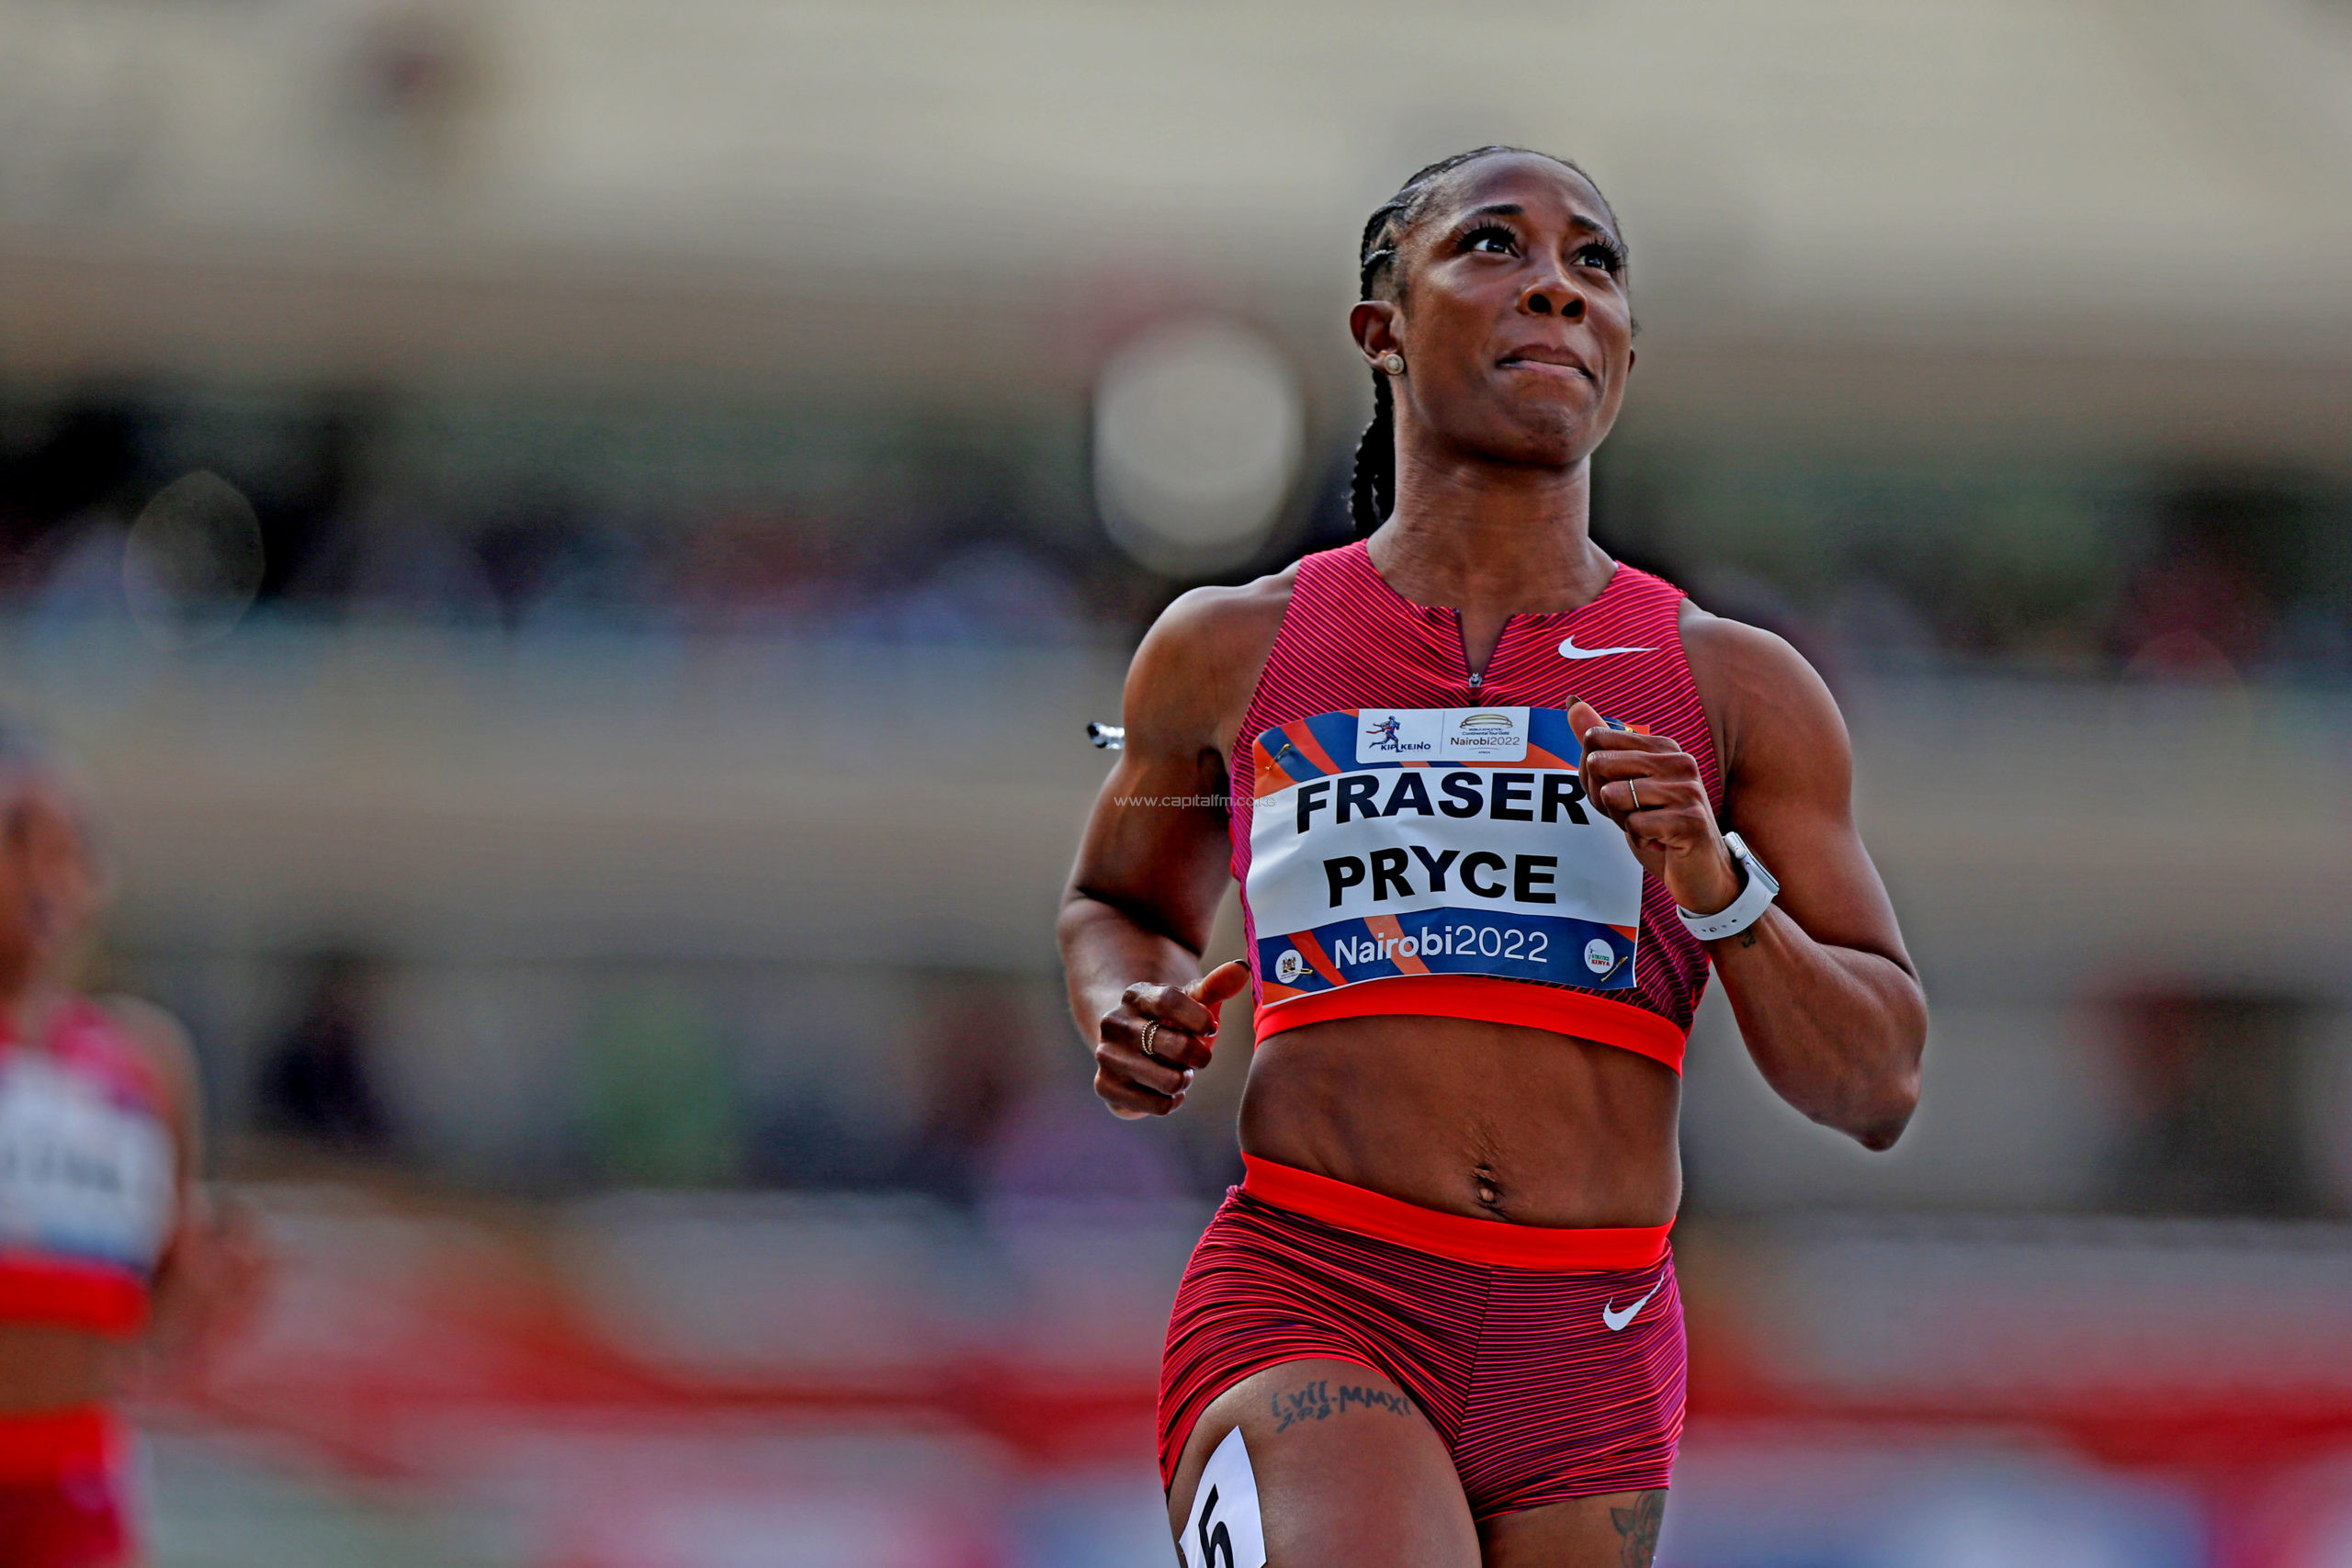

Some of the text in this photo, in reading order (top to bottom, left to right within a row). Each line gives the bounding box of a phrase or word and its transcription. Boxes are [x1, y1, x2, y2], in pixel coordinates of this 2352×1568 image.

[1400, 741, 1431, 750] KEINO
[1451, 737, 1521, 746] Nairobi2022
[1296, 772, 1590, 834] FRASER
[1323, 844, 1557, 908] PRYCE
[1335, 924, 1549, 970] Nairobi2022
